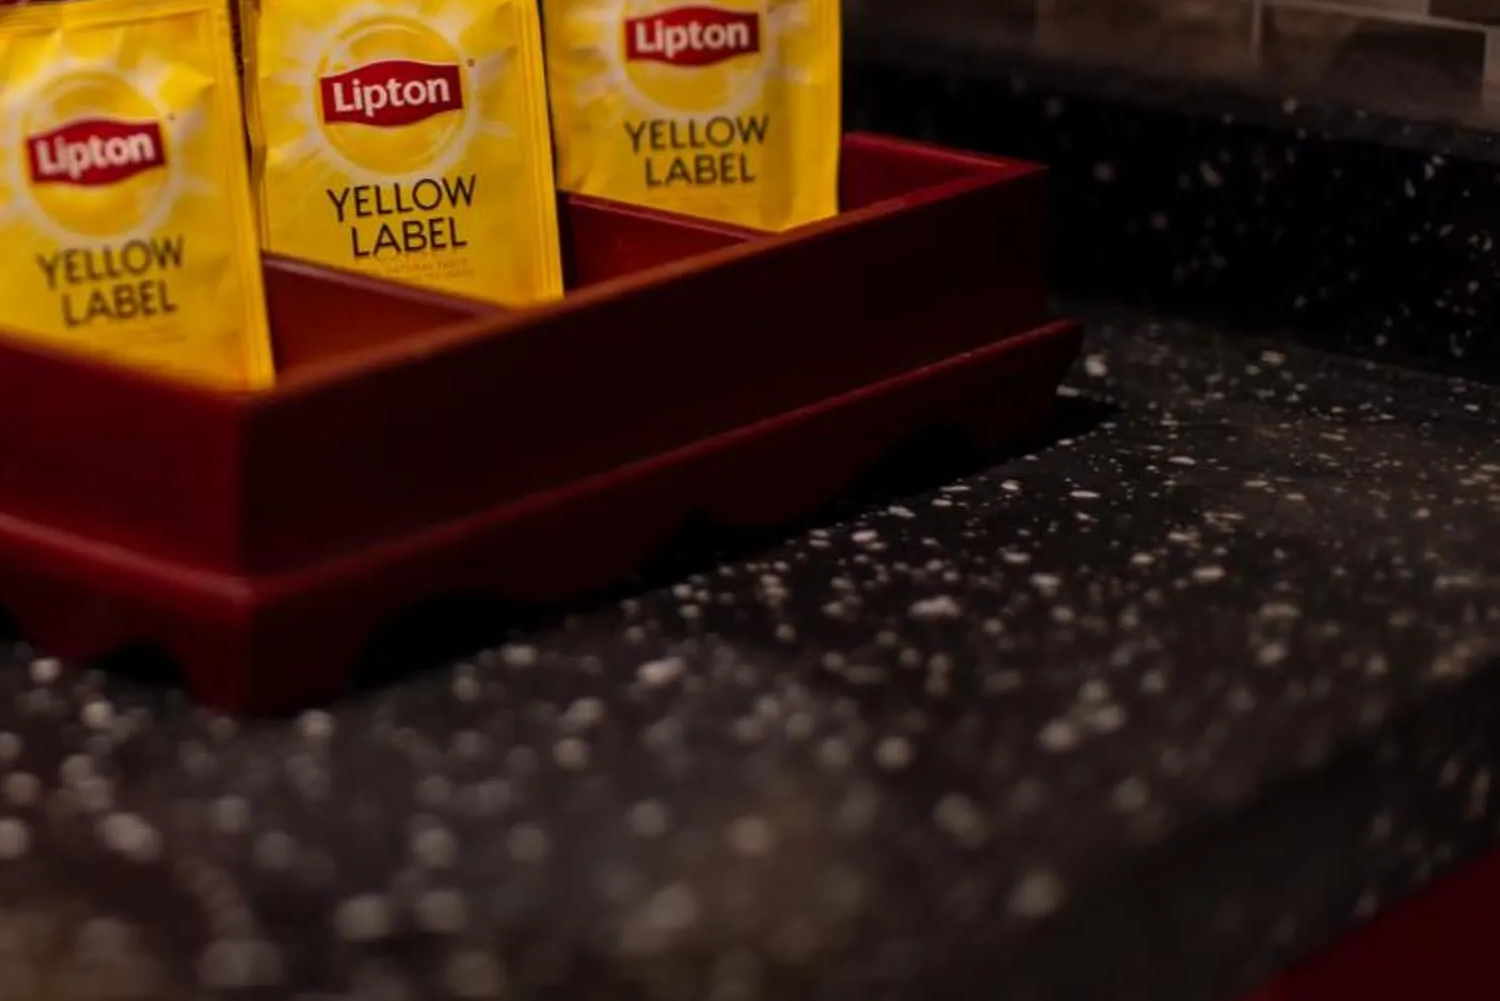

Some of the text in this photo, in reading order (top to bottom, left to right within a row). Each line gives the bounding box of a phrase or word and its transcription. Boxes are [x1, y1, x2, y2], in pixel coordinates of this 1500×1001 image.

[635, 19, 750, 58] Lipton
[332, 77, 451, 117] Lipton
[36, 132, 155, 178] Lipton
[624, 115, 769, 153] YELLOW
[645, 153, 756, 188] LABEL
[327, 174, 476, 222] YELLOW
[352, 216, 467, 258] LABEL
[36, 234, 184, 288] YELLOW
[62, 280, 177, 327] LABEL
